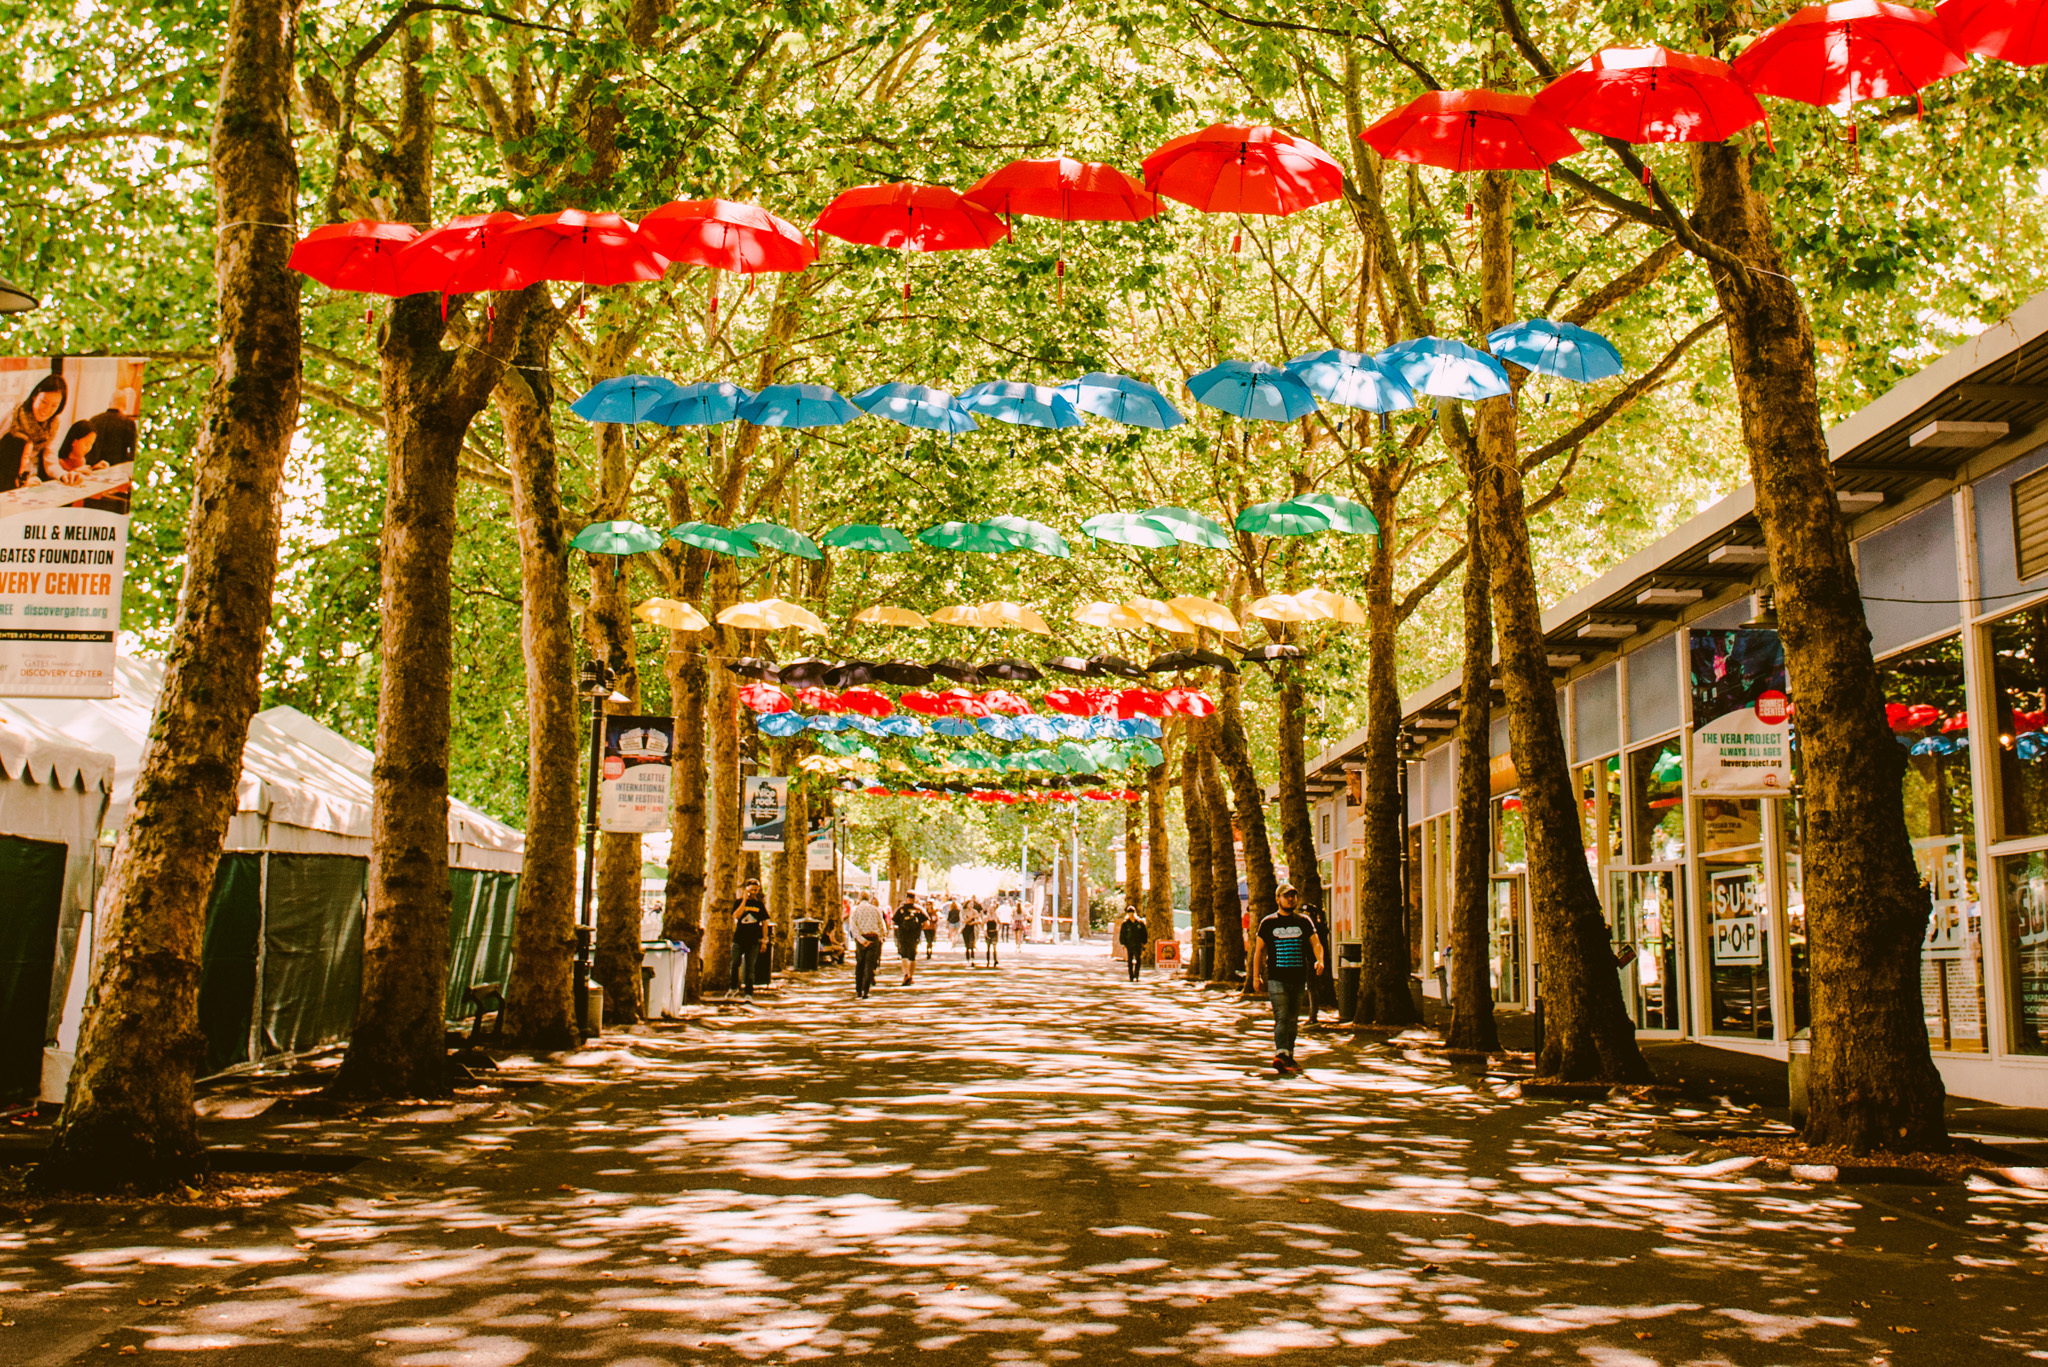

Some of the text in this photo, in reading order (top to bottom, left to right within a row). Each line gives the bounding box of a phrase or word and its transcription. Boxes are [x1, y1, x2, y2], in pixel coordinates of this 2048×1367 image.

[25, 525, 116, 541] BILL & MELINDA
[0, 548, 114, 565] GATES FOUNDATION
[0, 571, 111, 595] VERY CENTER
[24, 605, 108, 619] discovergates.org
[20, 669, 103, 678] DISCOVERY CENTER
[1702, 733, 1782, 745] THE VERA PROJECT
[1720, 748, 1782, 757] ALWAYS ALL AGES
[1720, 759, 1782, 768] theveraproject.org
[638, 773, 666, 782] SEATTLE
[615, 783, 665, 793] INTERNATIONAL
[755, 788, 776, 797] Nice
[618, 793, 664, 804] FILM FESTIVAL
